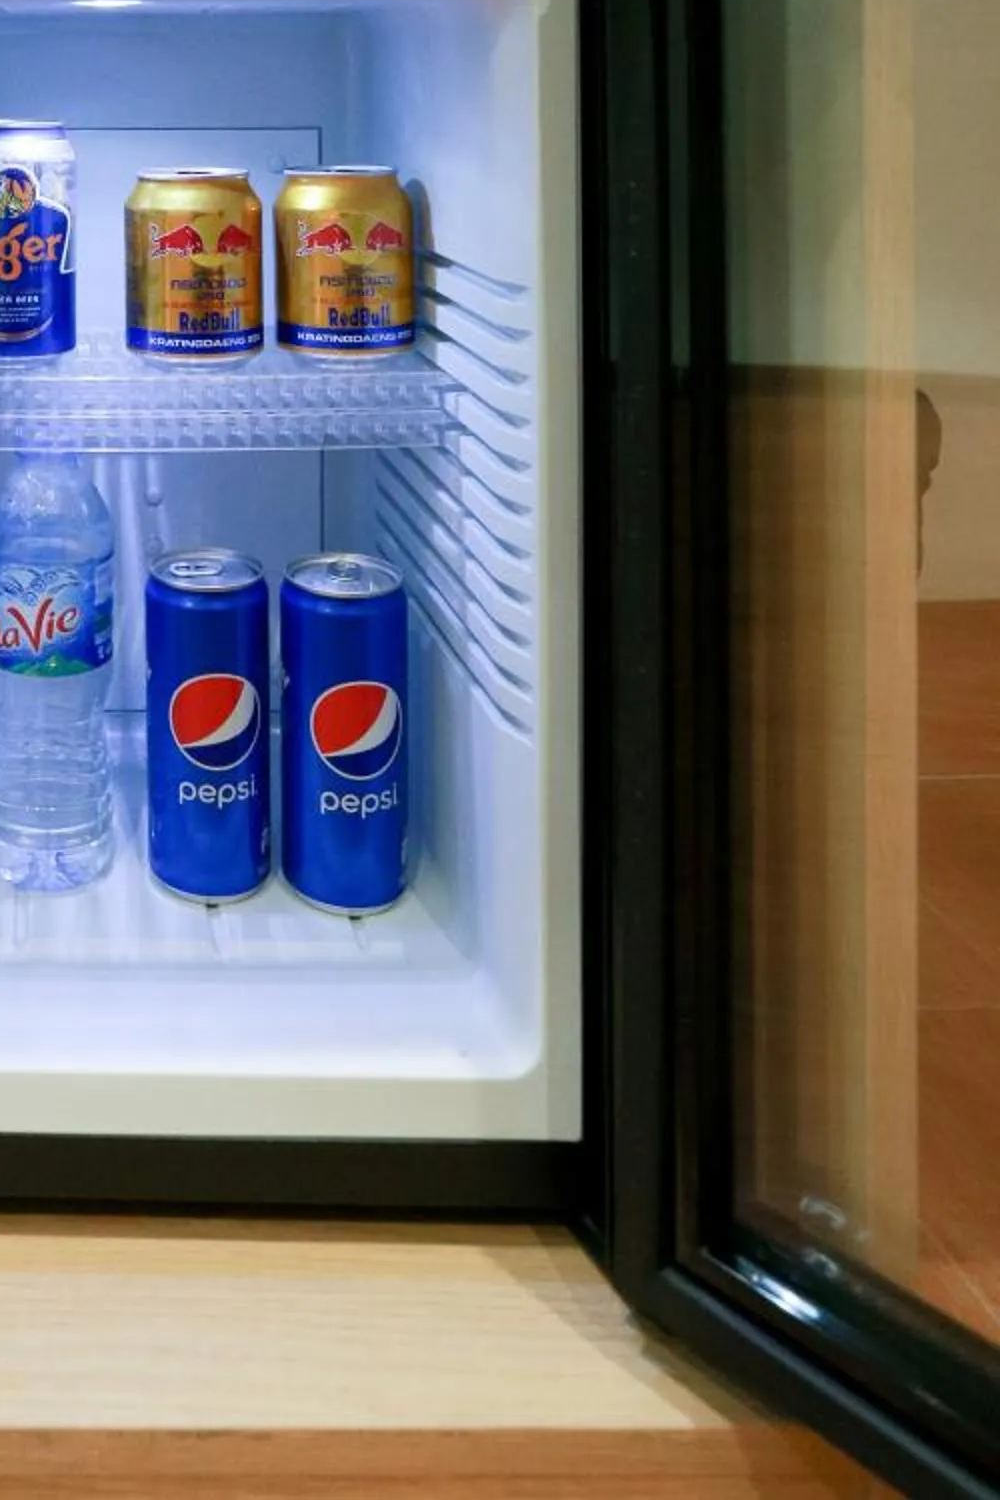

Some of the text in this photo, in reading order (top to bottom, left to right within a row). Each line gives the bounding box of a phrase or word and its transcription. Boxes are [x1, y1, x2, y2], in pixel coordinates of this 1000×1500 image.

[178, 307, 240, 332] RedBull
[328, 301, 391, 327] RedBull
[179, 774, 256, 809] pepsi
[320, 782, 398, 819] pepsi
